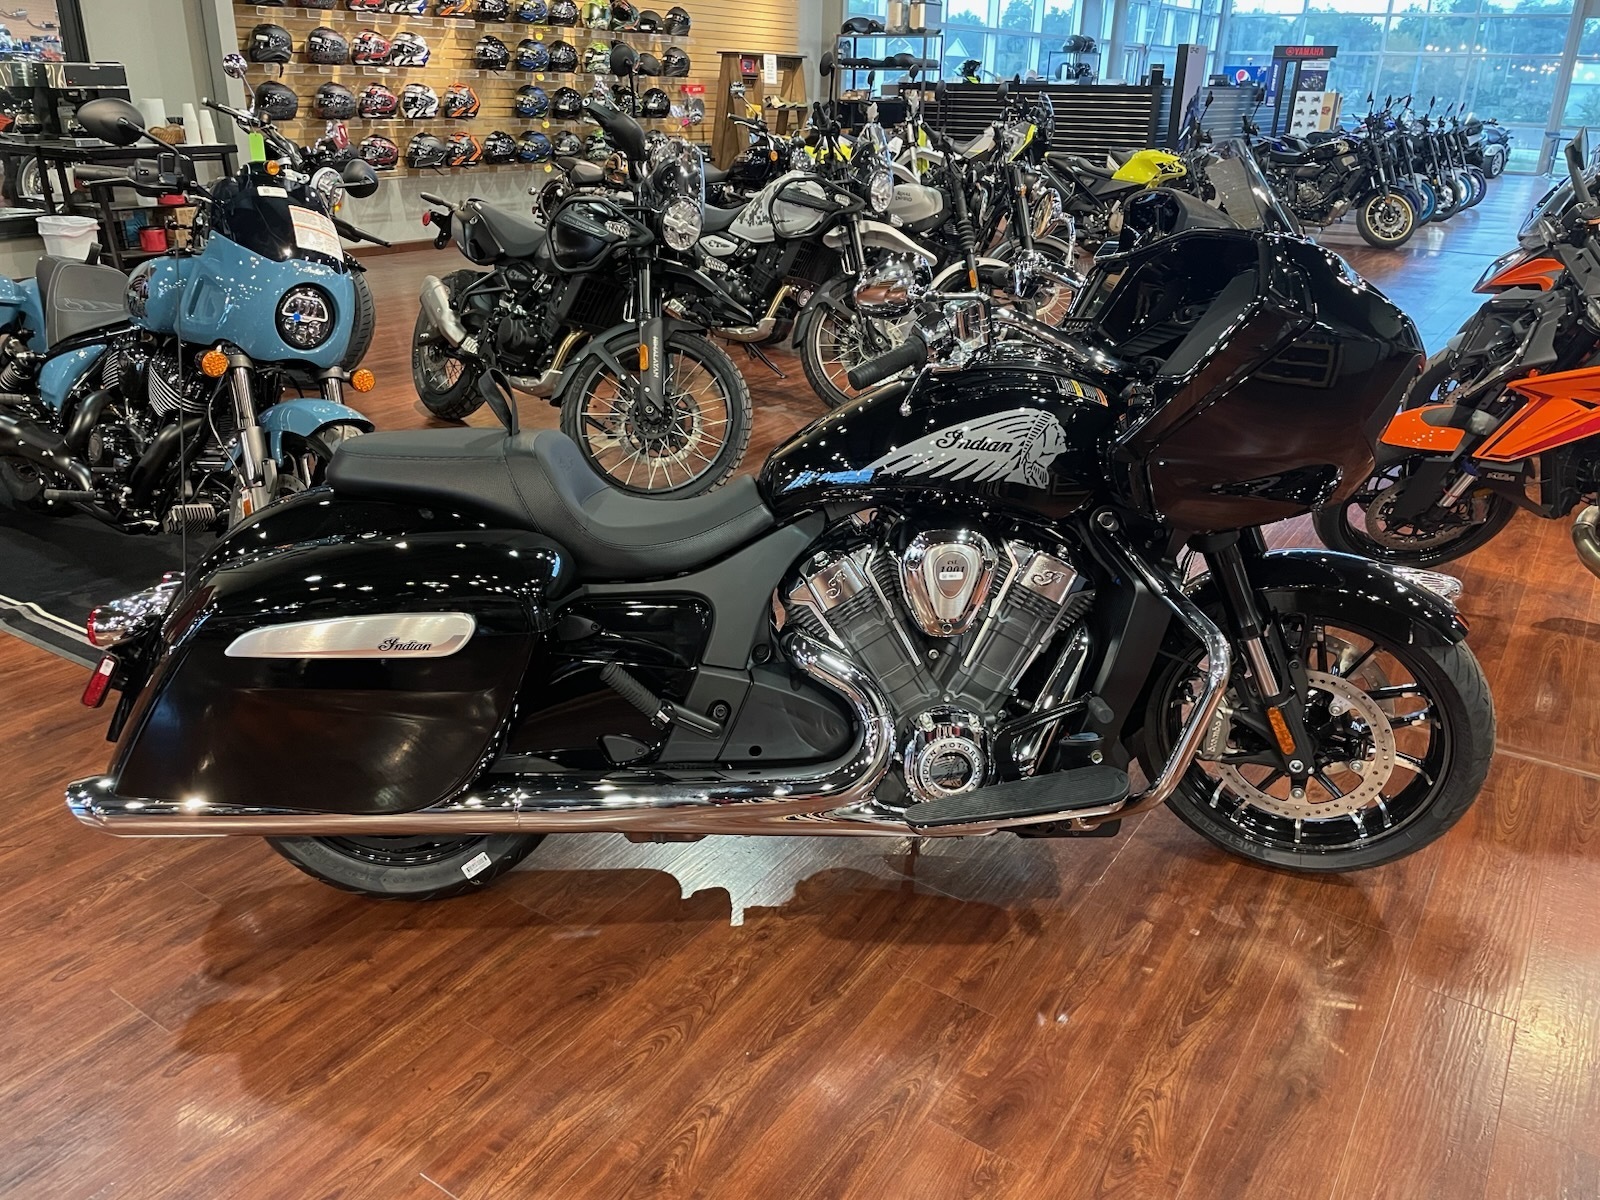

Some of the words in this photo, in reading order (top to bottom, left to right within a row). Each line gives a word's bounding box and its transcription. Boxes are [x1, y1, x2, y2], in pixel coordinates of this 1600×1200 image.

[1295, 47, 1324, 56] YAMAHA
[935, 429, 1014, 453] Indian
[377, 637, 432, 651] Indian
[1183, 805, 1258, 854] METZELER
